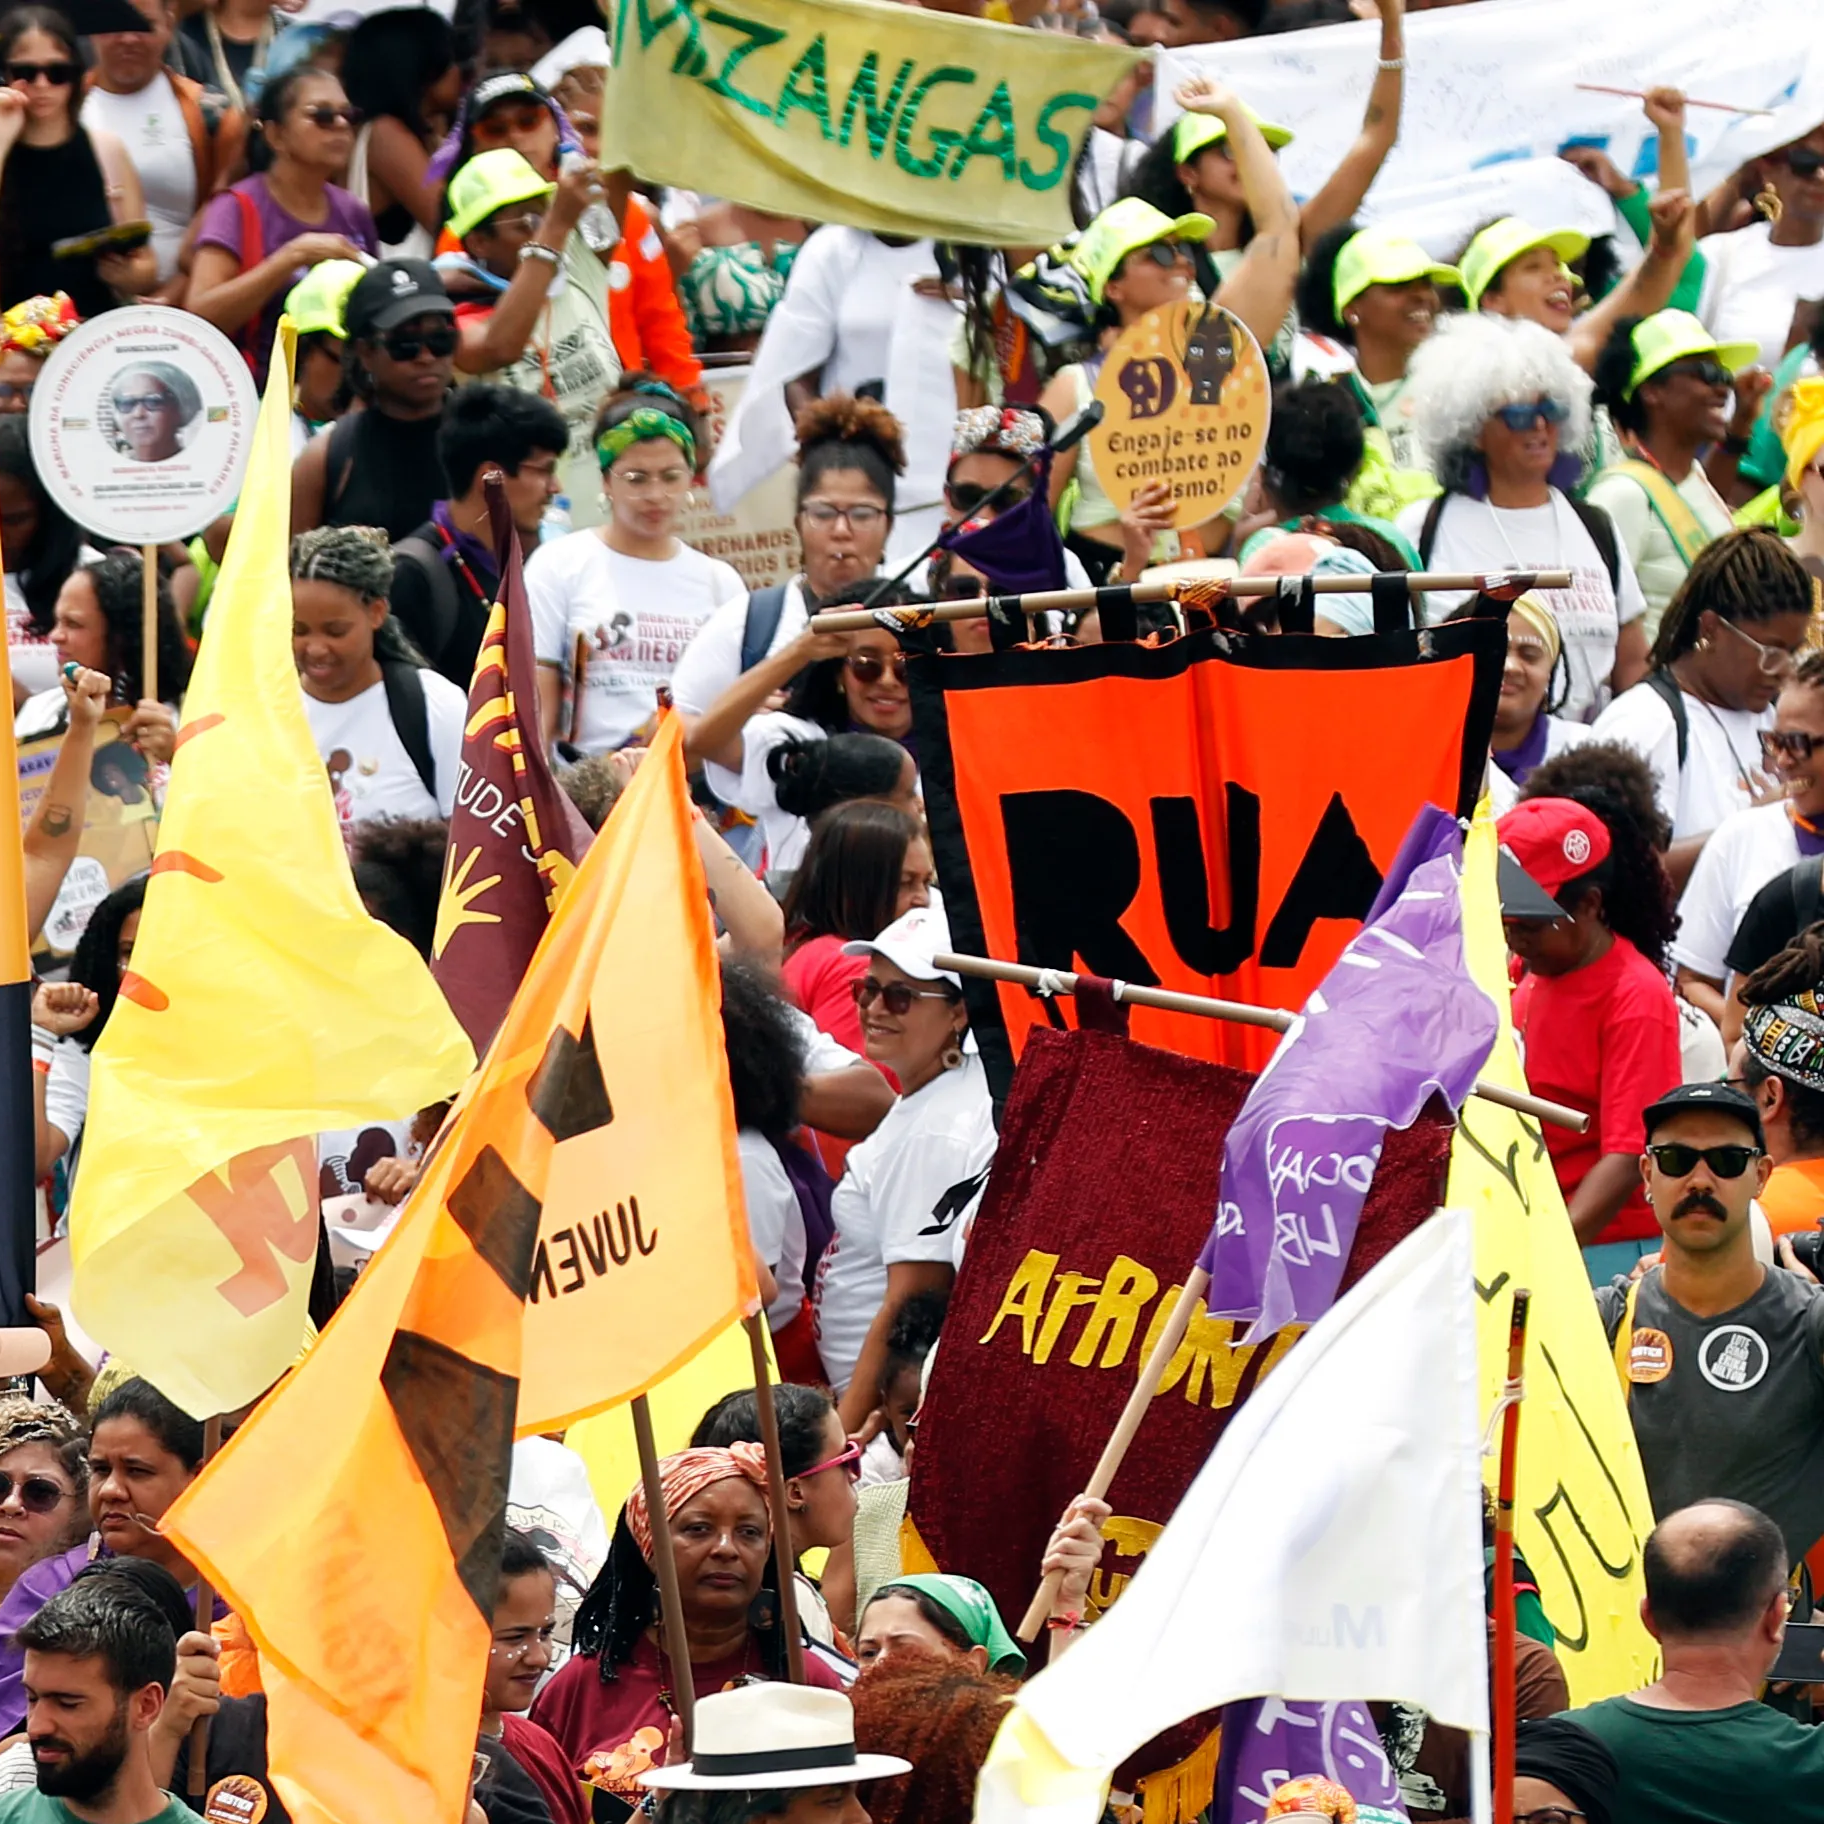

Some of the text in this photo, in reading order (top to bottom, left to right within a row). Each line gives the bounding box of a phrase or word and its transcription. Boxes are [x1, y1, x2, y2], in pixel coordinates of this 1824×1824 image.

[1108, 422, 1252, 456] Engaje-se no
[1115, 449, 1242, 479] combate ao
[636, 624, 699, 641] MULHE
[999, 780, 1386, 1015] RUA
